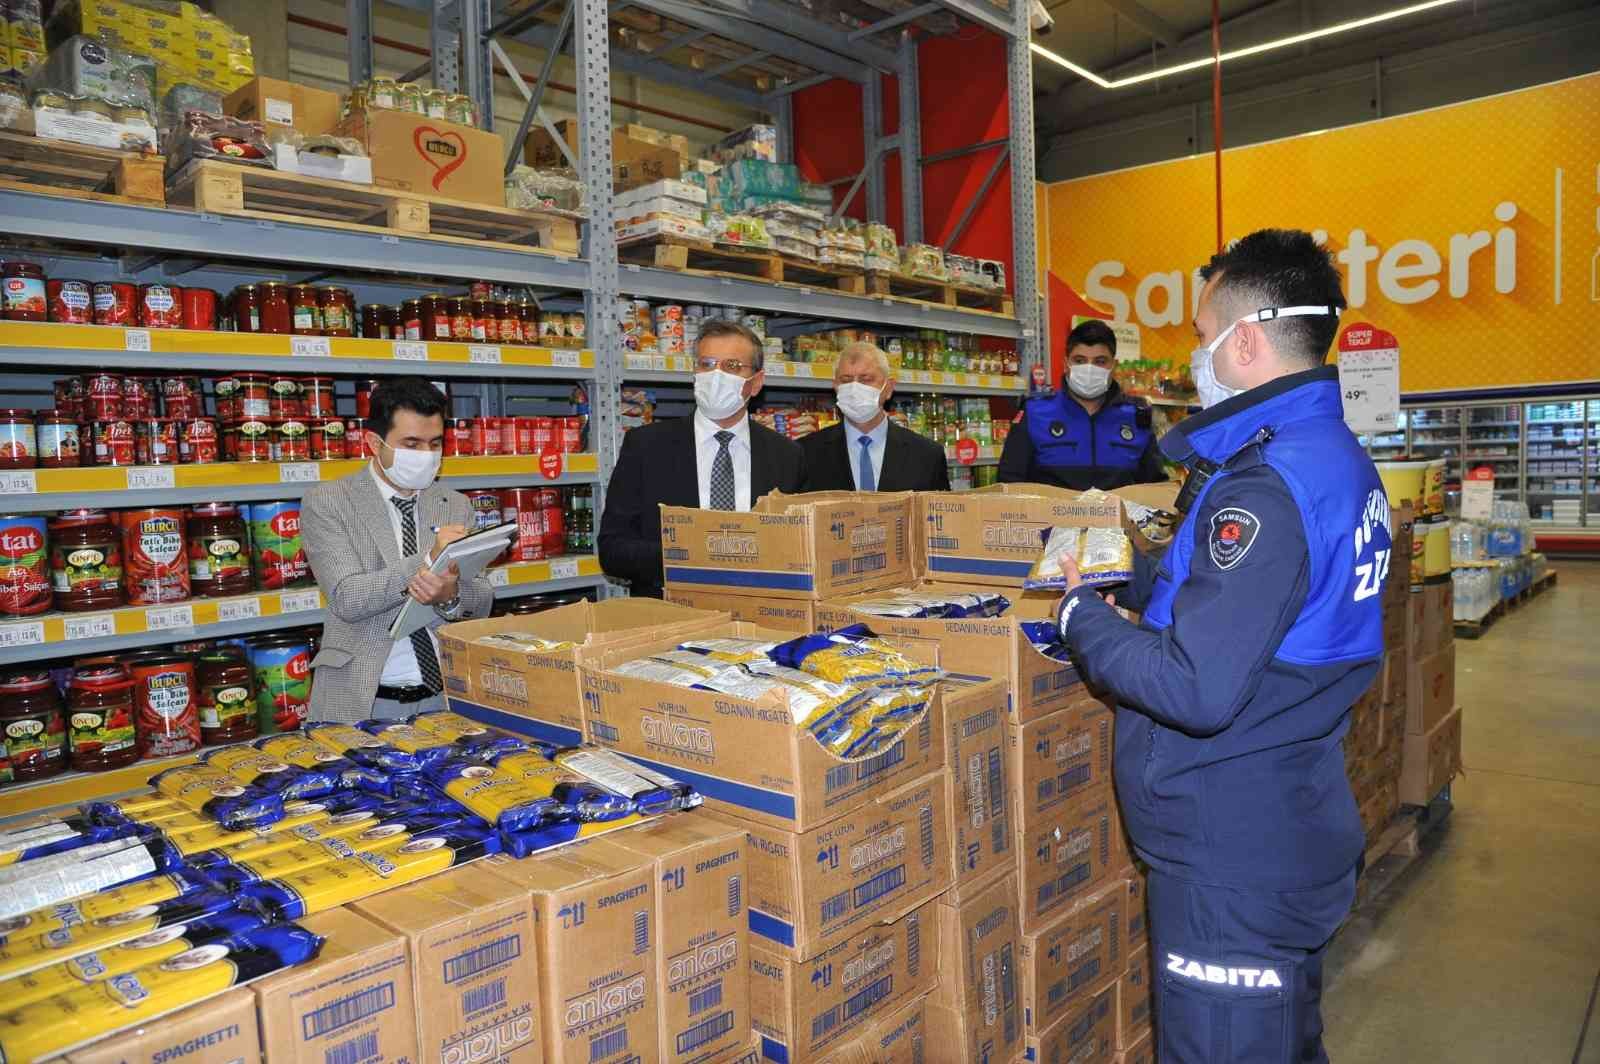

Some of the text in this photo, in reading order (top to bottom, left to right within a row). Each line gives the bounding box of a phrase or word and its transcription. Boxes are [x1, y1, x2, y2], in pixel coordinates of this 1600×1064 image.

[1, 533, 37, 551] tat
[714, 699, 755, 720] SEDANINI
[641, 709, 713, 754] ankara
[695, 850, 740, 874] SPAGHETTI
[598, 883, 648, 909] SPAGHETTI
[669, 938, 737, 984] ankara
[1166, 952, 1283, 988] ZABITA
[565, 976, 646, 1027] ankara
[151, 1023, 240, 1064] SPAGHETTI
